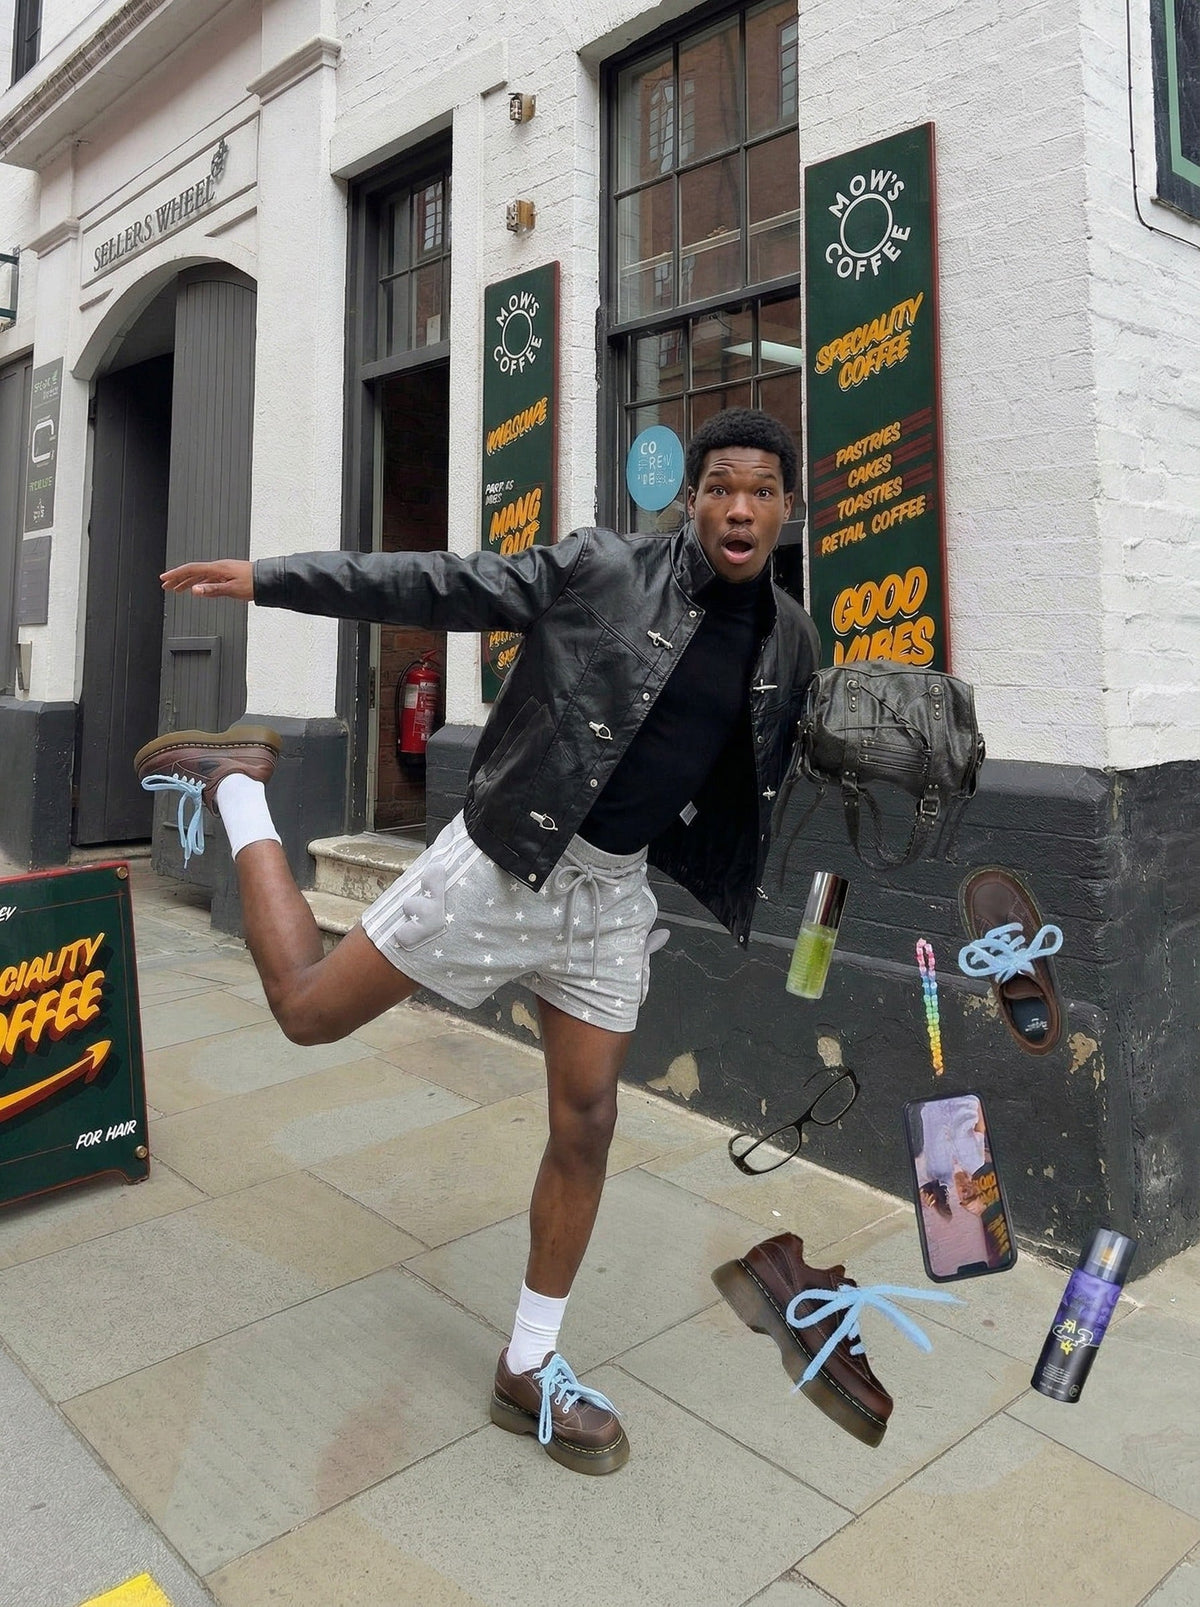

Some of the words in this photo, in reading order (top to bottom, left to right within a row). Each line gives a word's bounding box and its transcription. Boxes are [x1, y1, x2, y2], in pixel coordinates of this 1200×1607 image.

[828, 169, 905, 218] MOW'S
[93, 213, 153, 273] SELLERS
[155, 174, 216, 233] WHEEL
[825, 224, 911, 280] COFFEE
[496, 291, 540, 327] MOW'S
[815, 291, 924, 374] SPECIALITY
[493, 335, 542, 376] COFFEE
[838, 329, 912, 391] COFFEE
[835, 421, 901, 469] PASTRIES
[847, 453, 892, 488] CAKES
[837, 476, 903, 521] TOASTIES
[821, 521, 867, 555] RETAIL
[871, 494, 926, 535] COFFEE
[831, 566, 928, 636] GOOD
[833, 615, 936, 669] VIBES
[75, 1129, 103, 1150] FOR
[105, 1119, 137, 1142] HAIR
